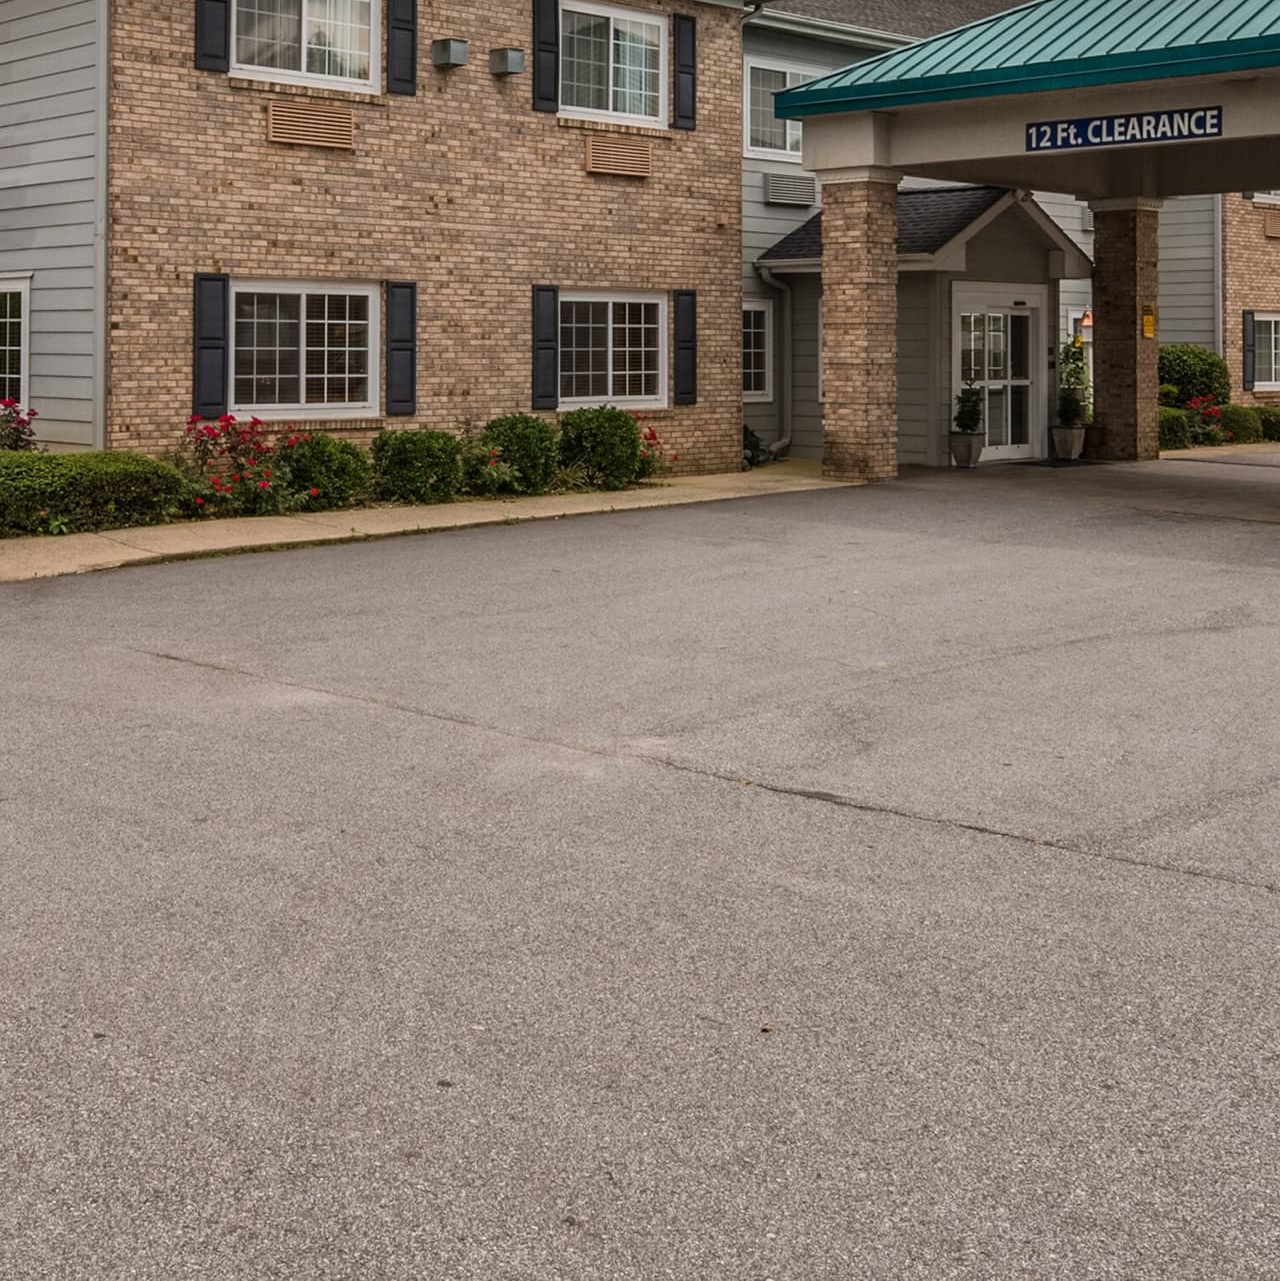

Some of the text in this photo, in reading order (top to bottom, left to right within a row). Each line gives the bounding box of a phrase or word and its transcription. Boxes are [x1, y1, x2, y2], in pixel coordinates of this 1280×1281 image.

[1028, 109, 1219, 148] 12 Ft. CLEARANCE
